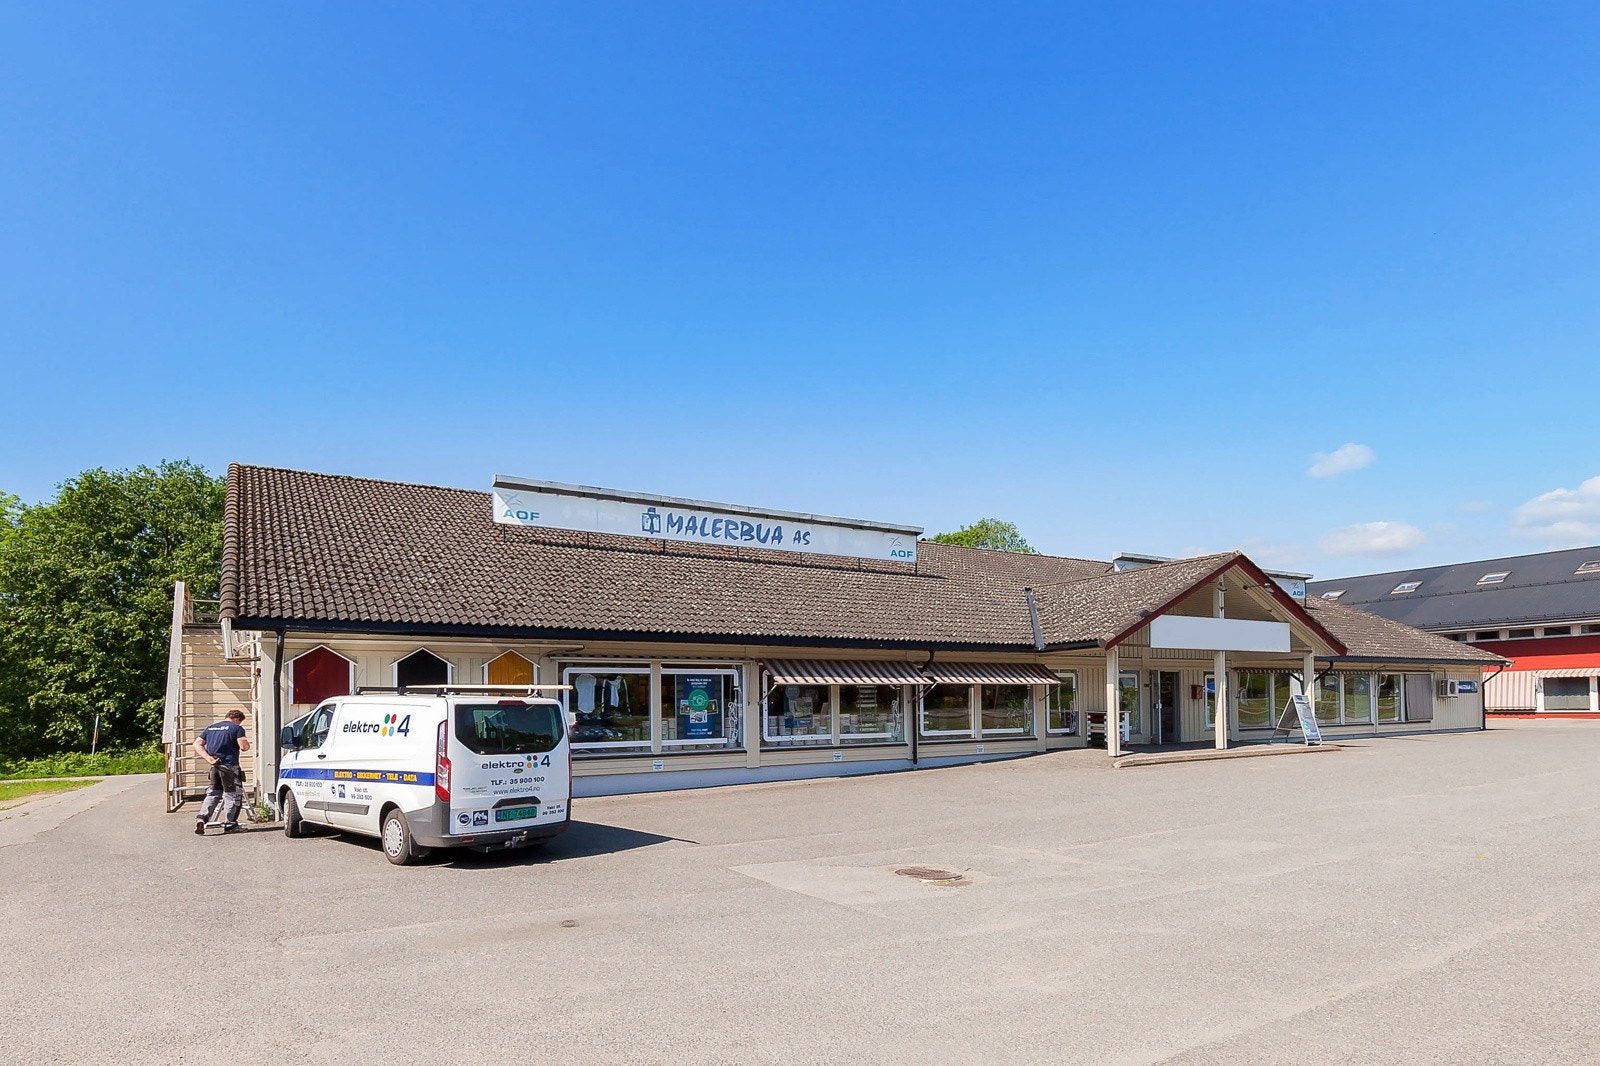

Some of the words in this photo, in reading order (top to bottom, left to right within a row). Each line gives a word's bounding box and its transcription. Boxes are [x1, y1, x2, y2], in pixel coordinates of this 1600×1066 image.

[503, 509, 540, 521] AOF
[666, 512, 783, 545] MALERBUA
[793, 530, 811, 545] AS
[891, 550, 914, 558] AOF
[343, 720, 380, 733] elektro
[397, 714, 411, 737] 4
[481, 760, 525, 770] elektro
[540, 755, 551, 767] 4
[493, 786, 541, 795] www.elektro4.no
[502, 811, 512, 819] NF
